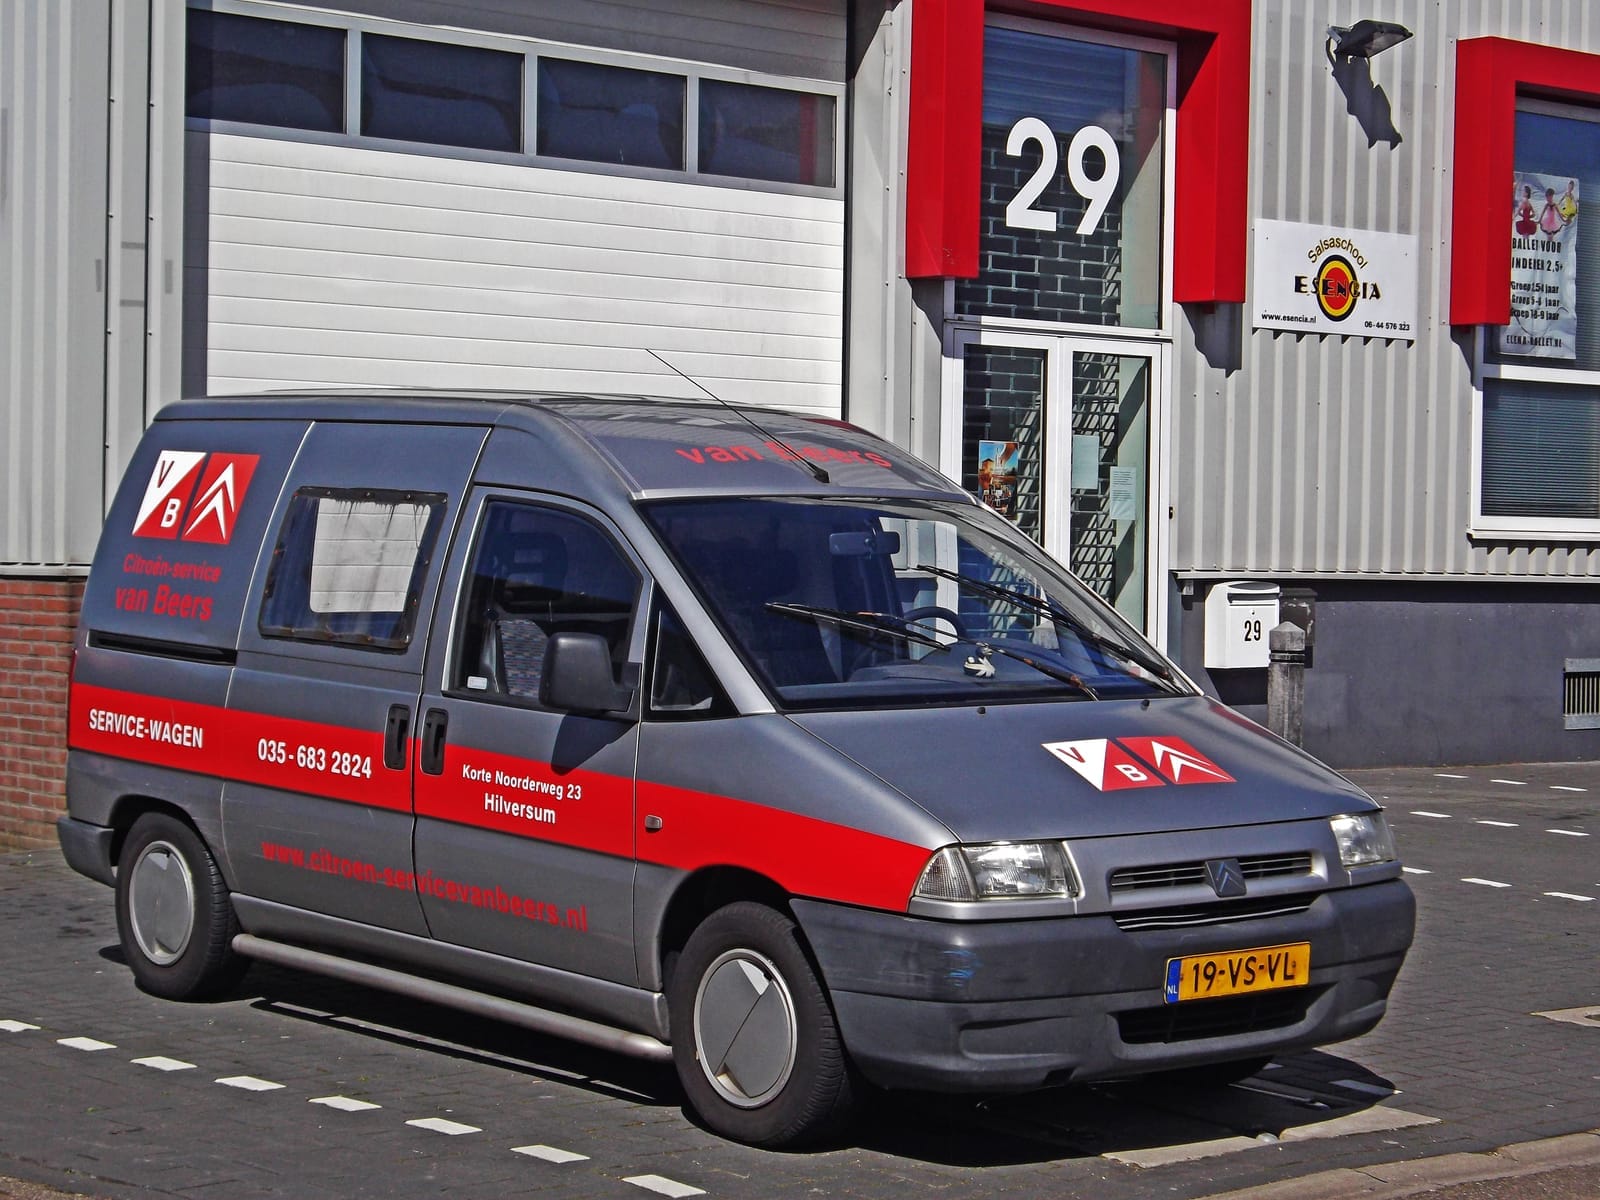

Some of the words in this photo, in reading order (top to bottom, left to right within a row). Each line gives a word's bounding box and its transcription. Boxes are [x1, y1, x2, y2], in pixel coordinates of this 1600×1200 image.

[1006, 117, 1120, 236] 29
[1307, 236, 1369, 270] Salsaschool
[1512, 237, 1539, 251] BALLET
[1540, 240, 1562, 254] VOOR
[1294, 275, 1382, 301] ESENCIA
[1545, 284, 1560, 294] jaar
[1545, 297, 1560, 308] jaar
[1261, 312, 1317, 324] www.esencia.nl
[1385, 322, 1398, 330] 576
[1398, 323, 1410, 331] 323
[675, 444, 764, 465] van
[763, 440, 893, 469] Beers
[157, 460, 175, 489] V
[160, 498, 181, 528] B
[115, 586, 149, 613] van
[152, 583, 214, 621] Beers
[1244, 620, 1262, 642] 29
[88, 708, 204, 749] SERVICE-WAGEN
[330, 750, 373, 779] 2824
[1114, 764, 1149, 782] B
[462, 764, 492, 783] Korte
[495, 771, 564, 800] Noorderweg
[566, 783, 582, 800] 23
[484, 792, 556, 824] Hilversum
[261, 841, 589, 932] www.citroen-servicevanbeers.nl
[1192, 951, 1296, 993] 19-VS-VL
[1167, 985, 1178, 994] NL
